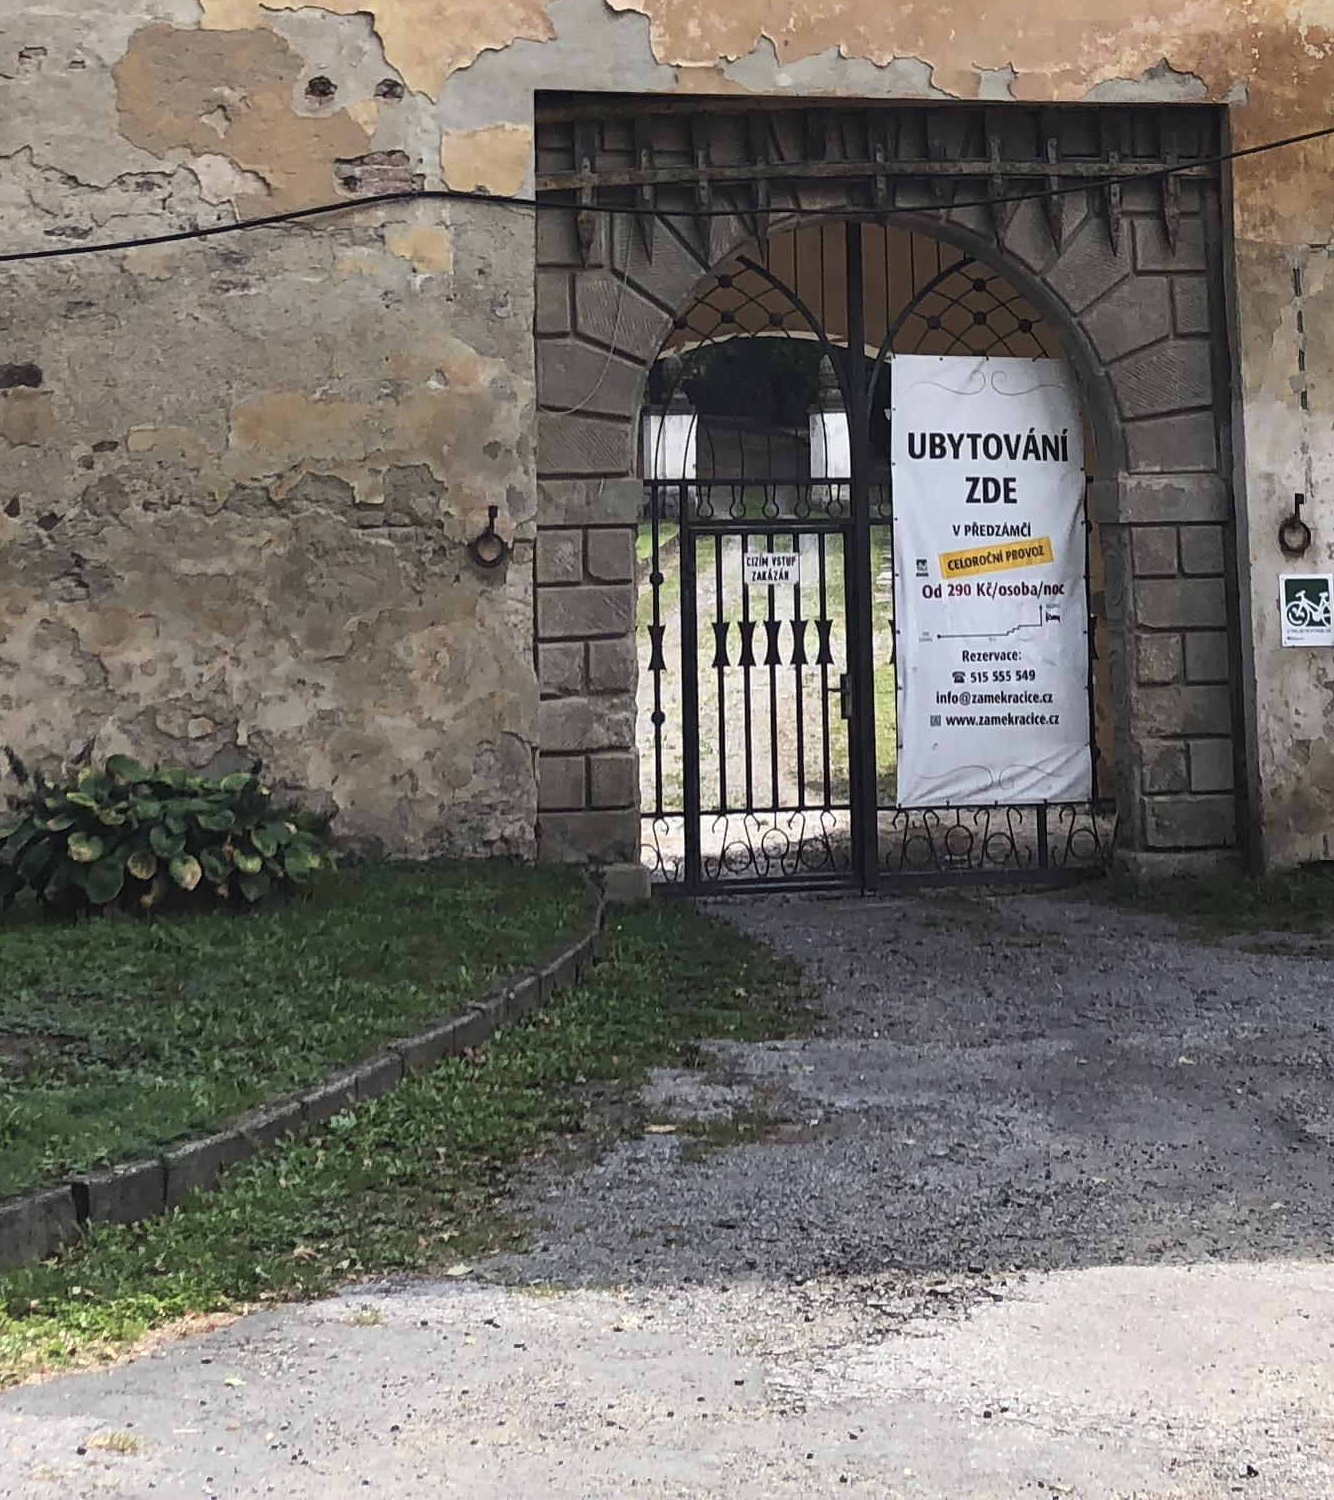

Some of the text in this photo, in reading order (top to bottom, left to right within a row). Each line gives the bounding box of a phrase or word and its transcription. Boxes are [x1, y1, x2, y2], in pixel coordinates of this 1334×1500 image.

[907, 427, 1068, 462] UBYTOVÁNÍ
[965, 476, 1018, 504] ZDE
[952, 522, 1031, 537] V PŘEDZÁMČÍ
[772, 556, 796, 566] VSTUP
[948, 545, 1045, 571] CELOROČNÍ PROVOZ
[752, 568, 789, 581] ZAKÁZÁN
[922, 580, 1065, 600] Od 290 Kč/osoba/noc
[962, 650, 1021, 662] Rezervace:
[970, 669, 1036, 683] 515 555 549
[936, 690, 1053, 706] info@zamekracice.cz
[946, 712, 1059, 726] www.zamekracice.cz
